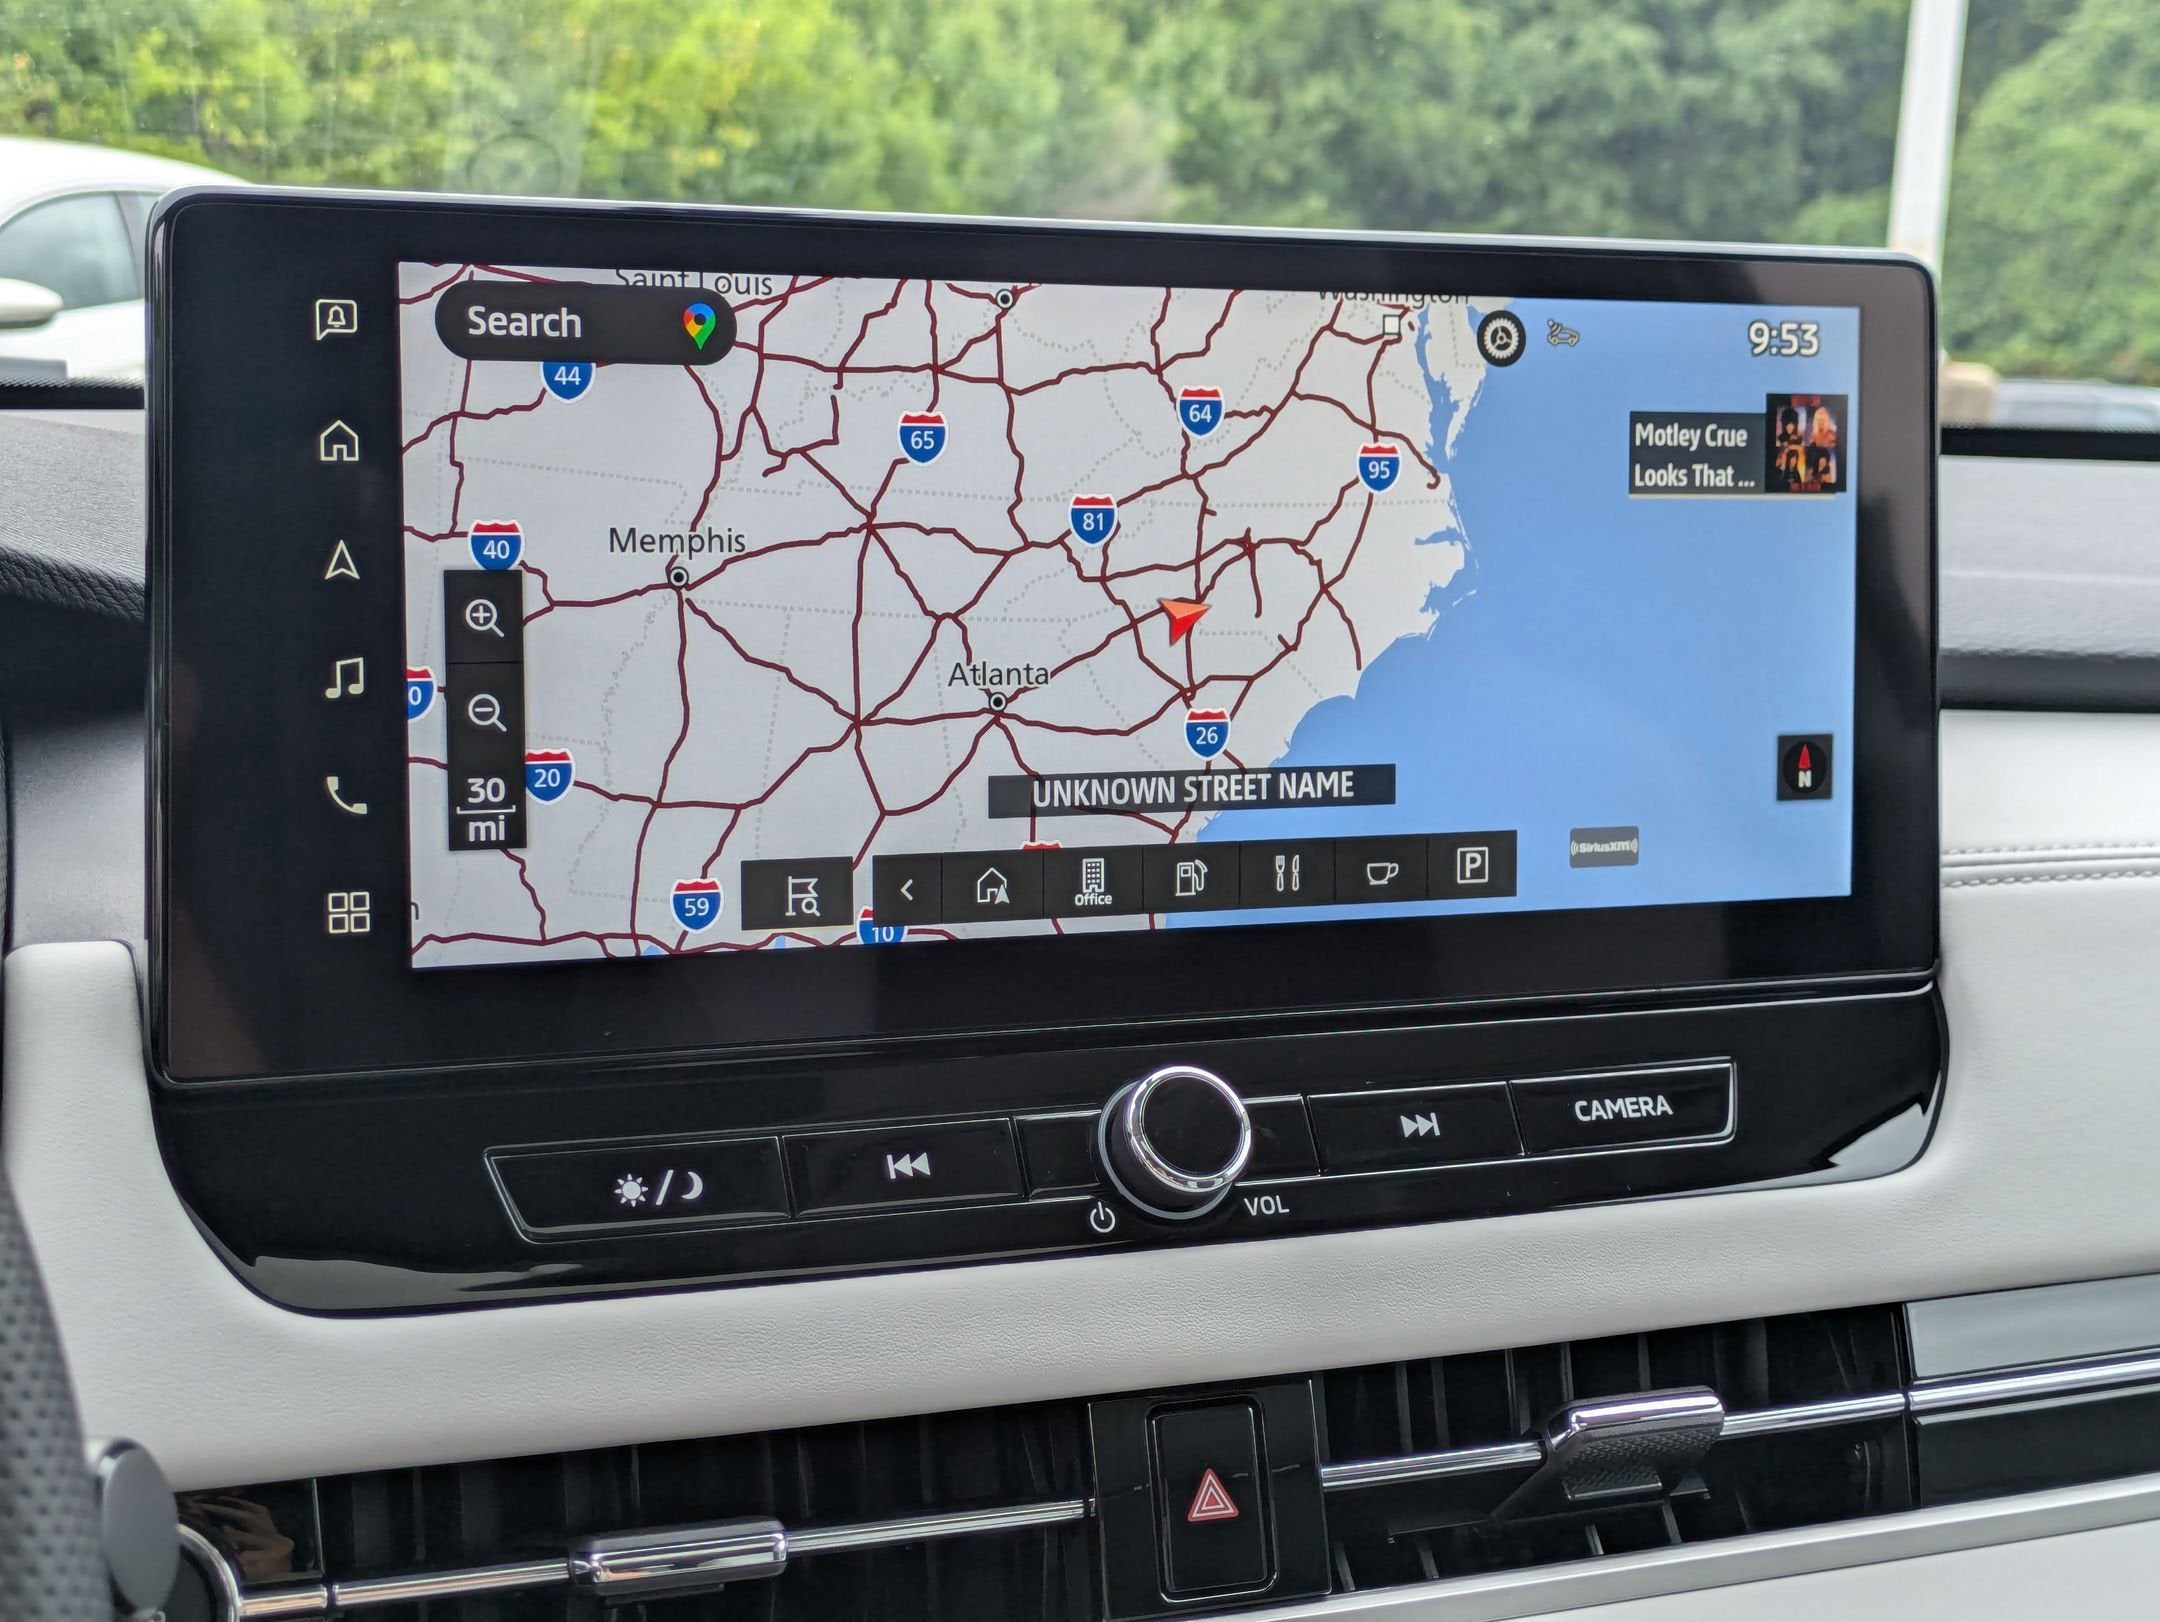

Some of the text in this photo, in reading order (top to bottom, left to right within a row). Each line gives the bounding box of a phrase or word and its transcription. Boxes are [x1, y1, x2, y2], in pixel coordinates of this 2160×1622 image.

[467, 306, 581, 338] Search
[1748, 321, 1820, 355] 9:53
[554, 366, 581, 386] 44
[1189, 404, 1212, 424] 64
[911, 431, 934, 451] 65
[1635, 423, 1748, 450] Motley Crue
[1369, 459, 1391, 479] 95
[1634, 464, 1688, 488] Looks
[1692, 465, 1734, 487] That
[1082, 513, 1105, 532] 81
[483, 541, 510, 560] 40
[608, 527, 746, 559] Memphis
[947, 661, 1049, 687] Atlanta
[1196, 725, 1219, 747] 26
[534, 769, 560, 789] 20
[1033, 770, 1355, 808] UNKNOWN STREET NAME
[1798, 770, 1812, 788] N
[468, 778, 505, 803] 30
[468, 815, 506, 842] mi
[1465, 852, 1482, 878] P
[684, 898, 709, 917] 59
[1074, 893, 1113, 906] Office
[871, 926, 895, 942] 10
[1573, 1094, 1674, 1123] CAMERA
[1244, 1195, 1290, 1216] VOL
